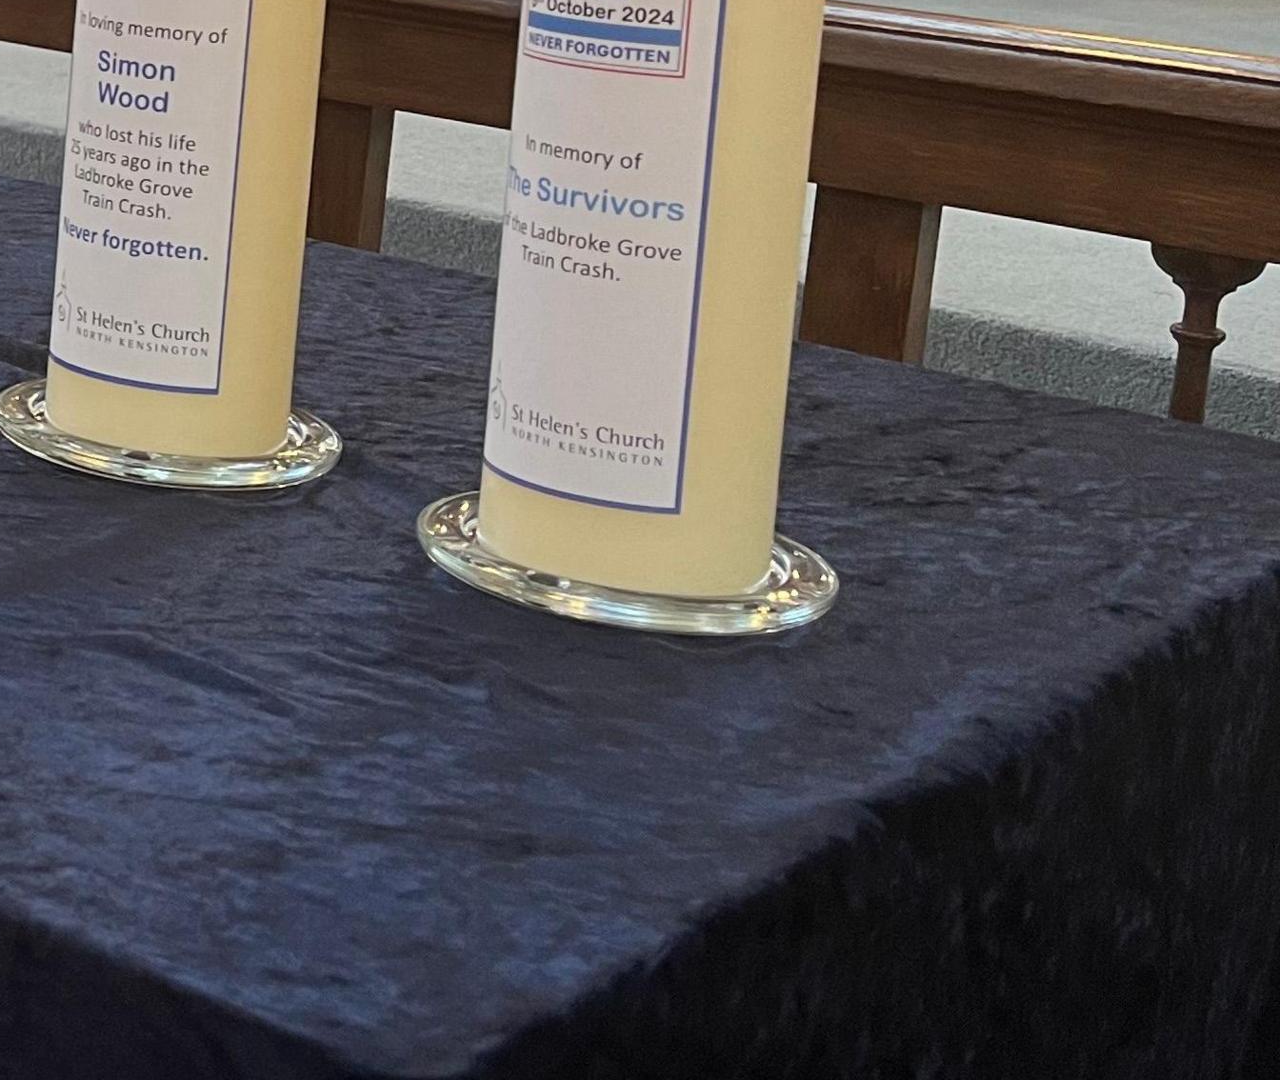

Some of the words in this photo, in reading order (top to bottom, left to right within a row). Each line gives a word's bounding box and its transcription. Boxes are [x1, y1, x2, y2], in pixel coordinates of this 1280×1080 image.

[88, 11, 124, 36] loving
[128, 21, 203, 45] memory
[208, 28, 228, 44] of
[622, 6, 674, 26] 2024
[97, 50, 176, 81] Simon
[528, 32, 562, 52] NEVER
[566, 39, 671, 65] FORGOTTEN
[98, 81, 170, 113] Wood
[78, 120, 102, 138] who
[105, 124, 133, 144] lost
[138, 130, 163, 148] his
[168, 133, 197, 152] life
[525, 133, 537, 153] In
[539, 141, 613, 170] memory
[620, 152, 644, 171] of
[83, 146, 117, 164] years
[121, 154, 151, 172] ago
[156, 156, 173, 173] in
[179, 159, 210, 176] the
[73, 163, 134, 191] Ladbroke
[139, 178, 194, 199] Grove
[82, 189, 114, 210] Train
[118, 199, 172, 221] Crash.
[536, 176, 686, 222] Survivors
[62, 215, 98, 244] Never
[102, 228, 209, 262] forgotten.
[530, 220, 611, 255] Ladbroke
[617, 238, 683, 262] Grove
[521, 245, 555, 269] Train
[560, 256, 622, 282] Crash.
[76, 306, 88, 323] St
[91, 311, 145, 336] Helen's
[151, 323, 211, 344] Church
[76, 325, 113, 344] NORTH
[119, 337, 209, 357] KENSINGTON
[511, 403, 524, 422] St
[529, 411, 589, 441] Helen's
[595, 425, 665, 451] Church
[511, 426, 551, 448] NORTH
[558, 441, 665, 467] KENSINGTON
